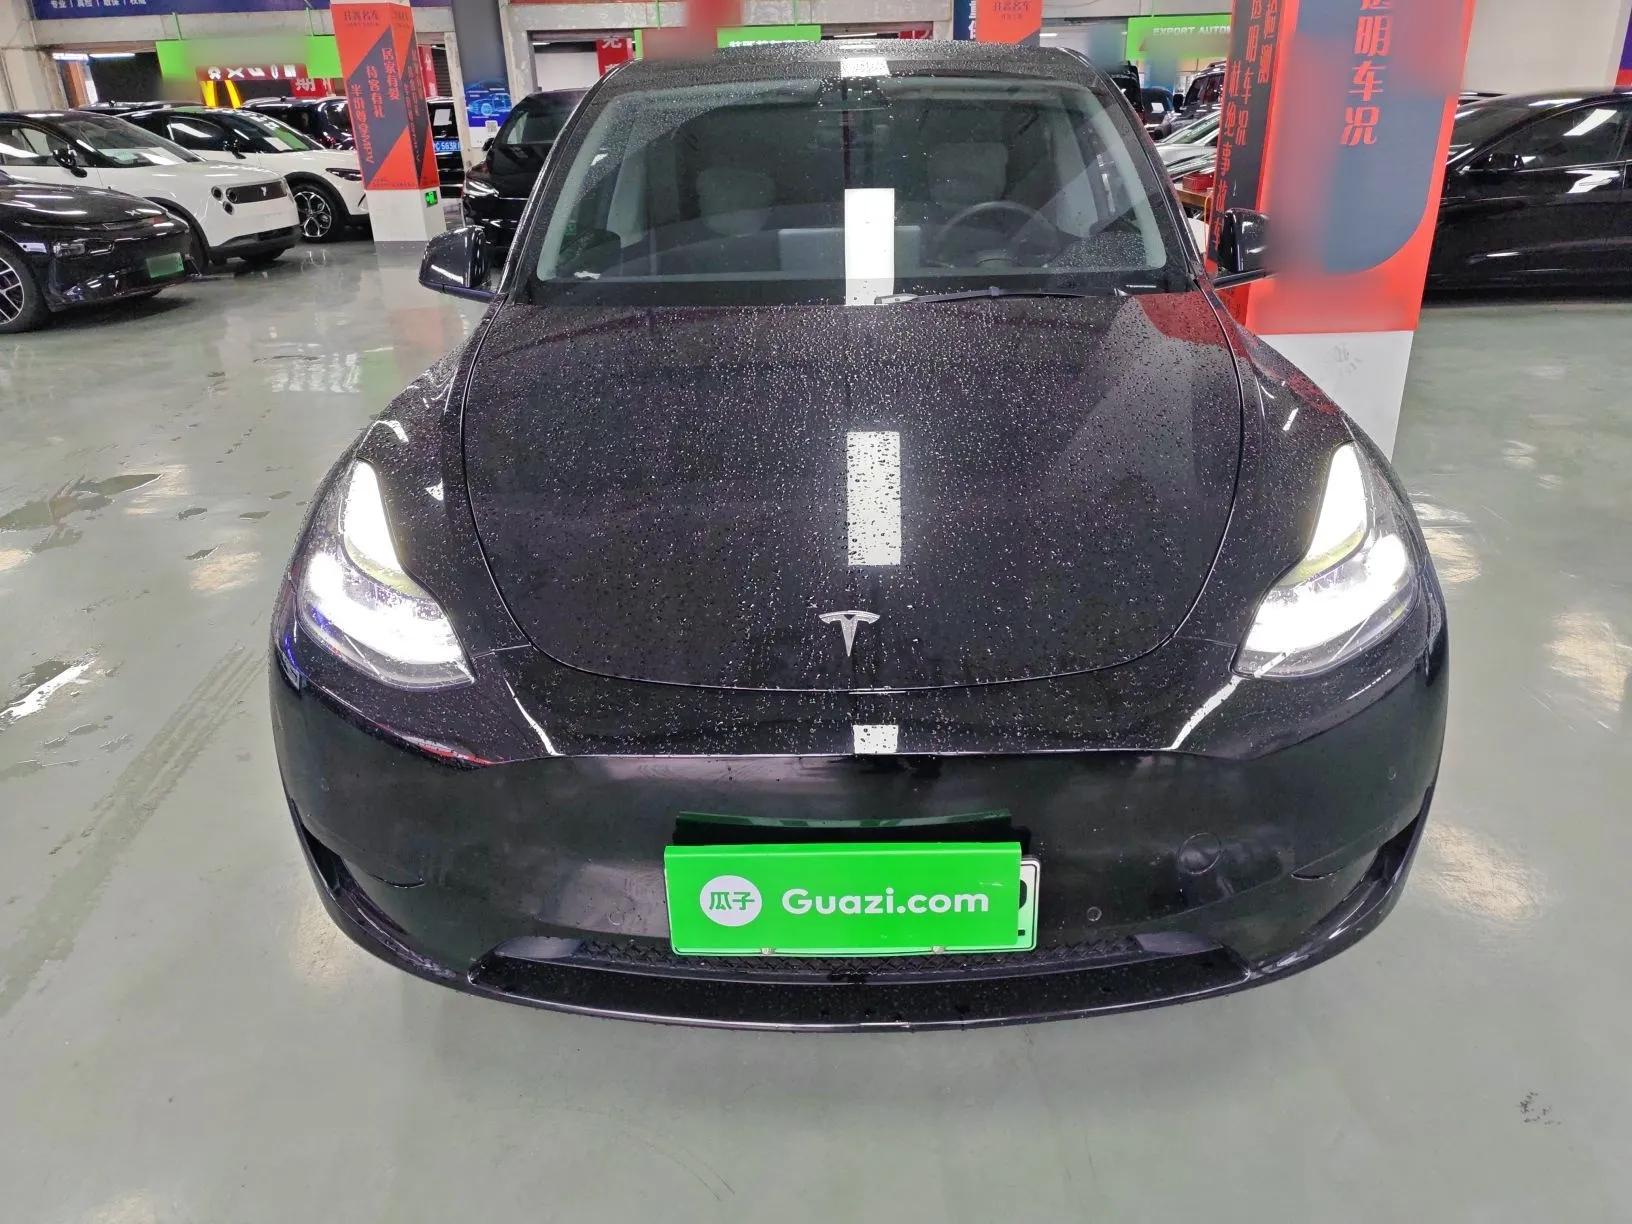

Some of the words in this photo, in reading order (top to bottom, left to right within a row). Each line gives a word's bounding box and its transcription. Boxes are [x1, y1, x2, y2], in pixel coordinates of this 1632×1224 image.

[1339, 0, 1394, 146] 明车况
[708, 891, 755, 912] 瓜子
[782, 887, 989, 915] Guazi.com
